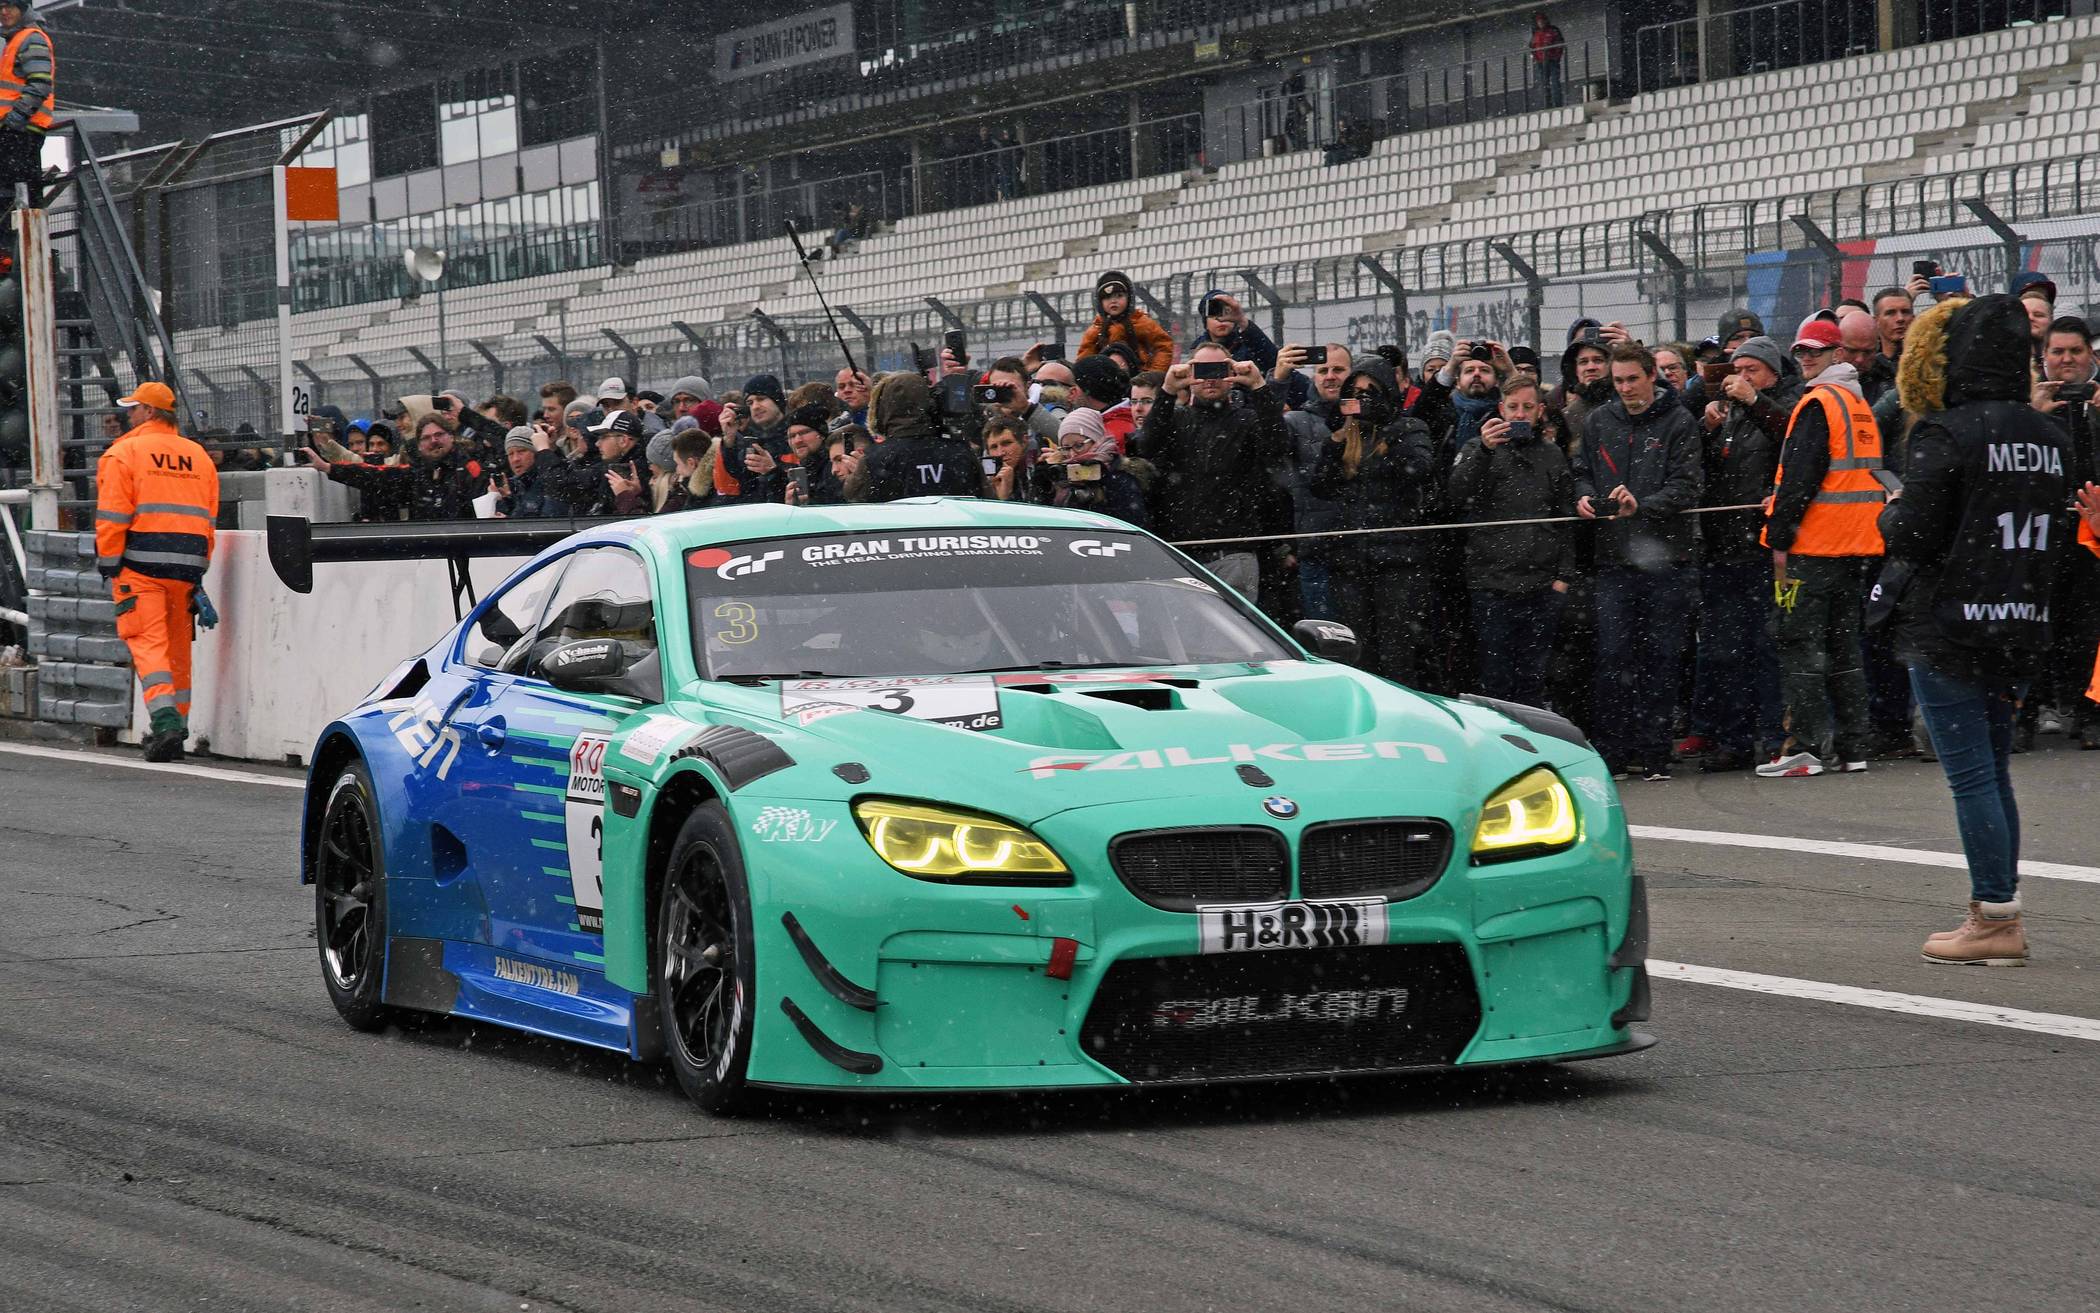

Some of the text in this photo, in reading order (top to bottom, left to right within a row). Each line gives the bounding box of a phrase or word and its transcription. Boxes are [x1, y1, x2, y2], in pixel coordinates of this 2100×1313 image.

[795, 17, 837, 54] POWER
[292, 386, 309, 415] 2a
[150, 453, 193, 472] VLN
[916, 463, 944, 484] TV
[1987, 443, 2063, 476] MEDIA
[801, 540, 891, 562] GRAN
[808, 559, 842, 568] THE
[843, 553, 886, 563] REAL
[890, 550, 952, 560] DRIVING
[714, 602, 758, 645] 3
[867, 688, 914, 715] 3
[1028, 741, 1448, 780] FALKEN
[571, 776, 605, 793] MOTOR
[494, 956, 579, 995] FALKENTYRE.COM
[1152, 988, 1408, 1028] FALKEN
